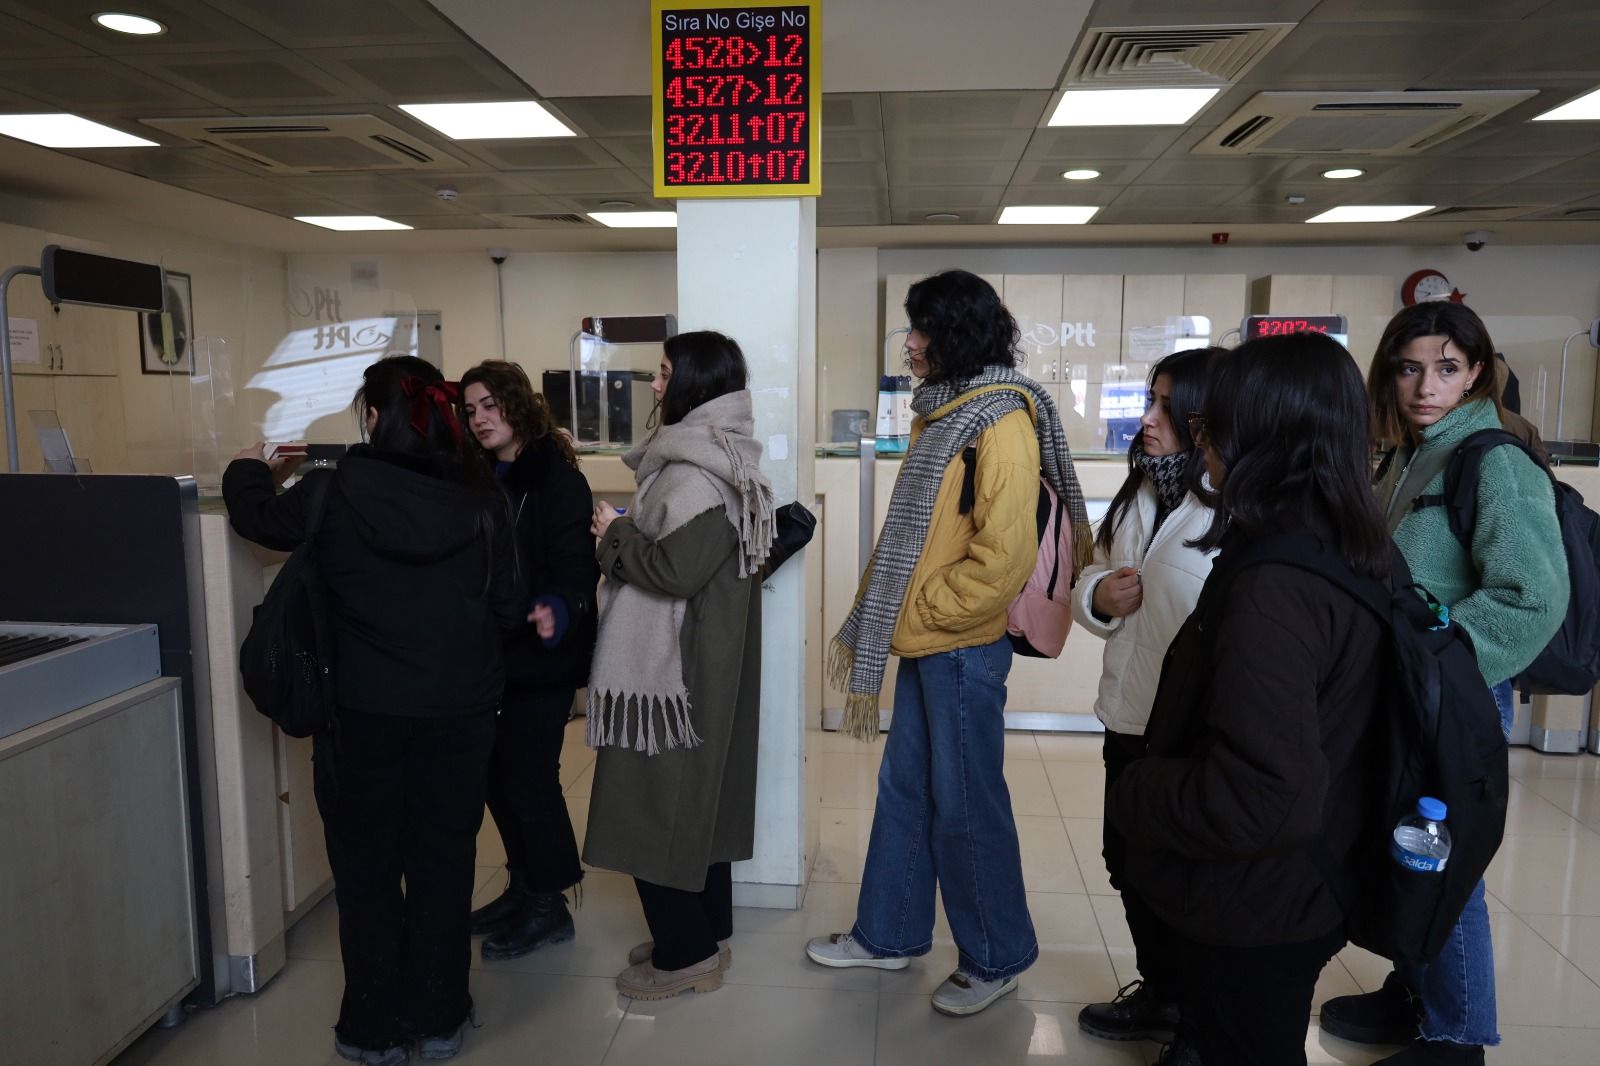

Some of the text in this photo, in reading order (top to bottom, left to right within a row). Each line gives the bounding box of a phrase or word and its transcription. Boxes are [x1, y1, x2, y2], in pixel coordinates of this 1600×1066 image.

[665, 10, 806, 32] Sıra No Gişe No
[666, 34, 803, 69] 4528 12
[666, 74, 803, 107] 4527 12
[667, 112, 805, 146] 3211 07
[667, 150, 805, 183] 3210 07
[1060, 322, 1096, 347] Ptt
